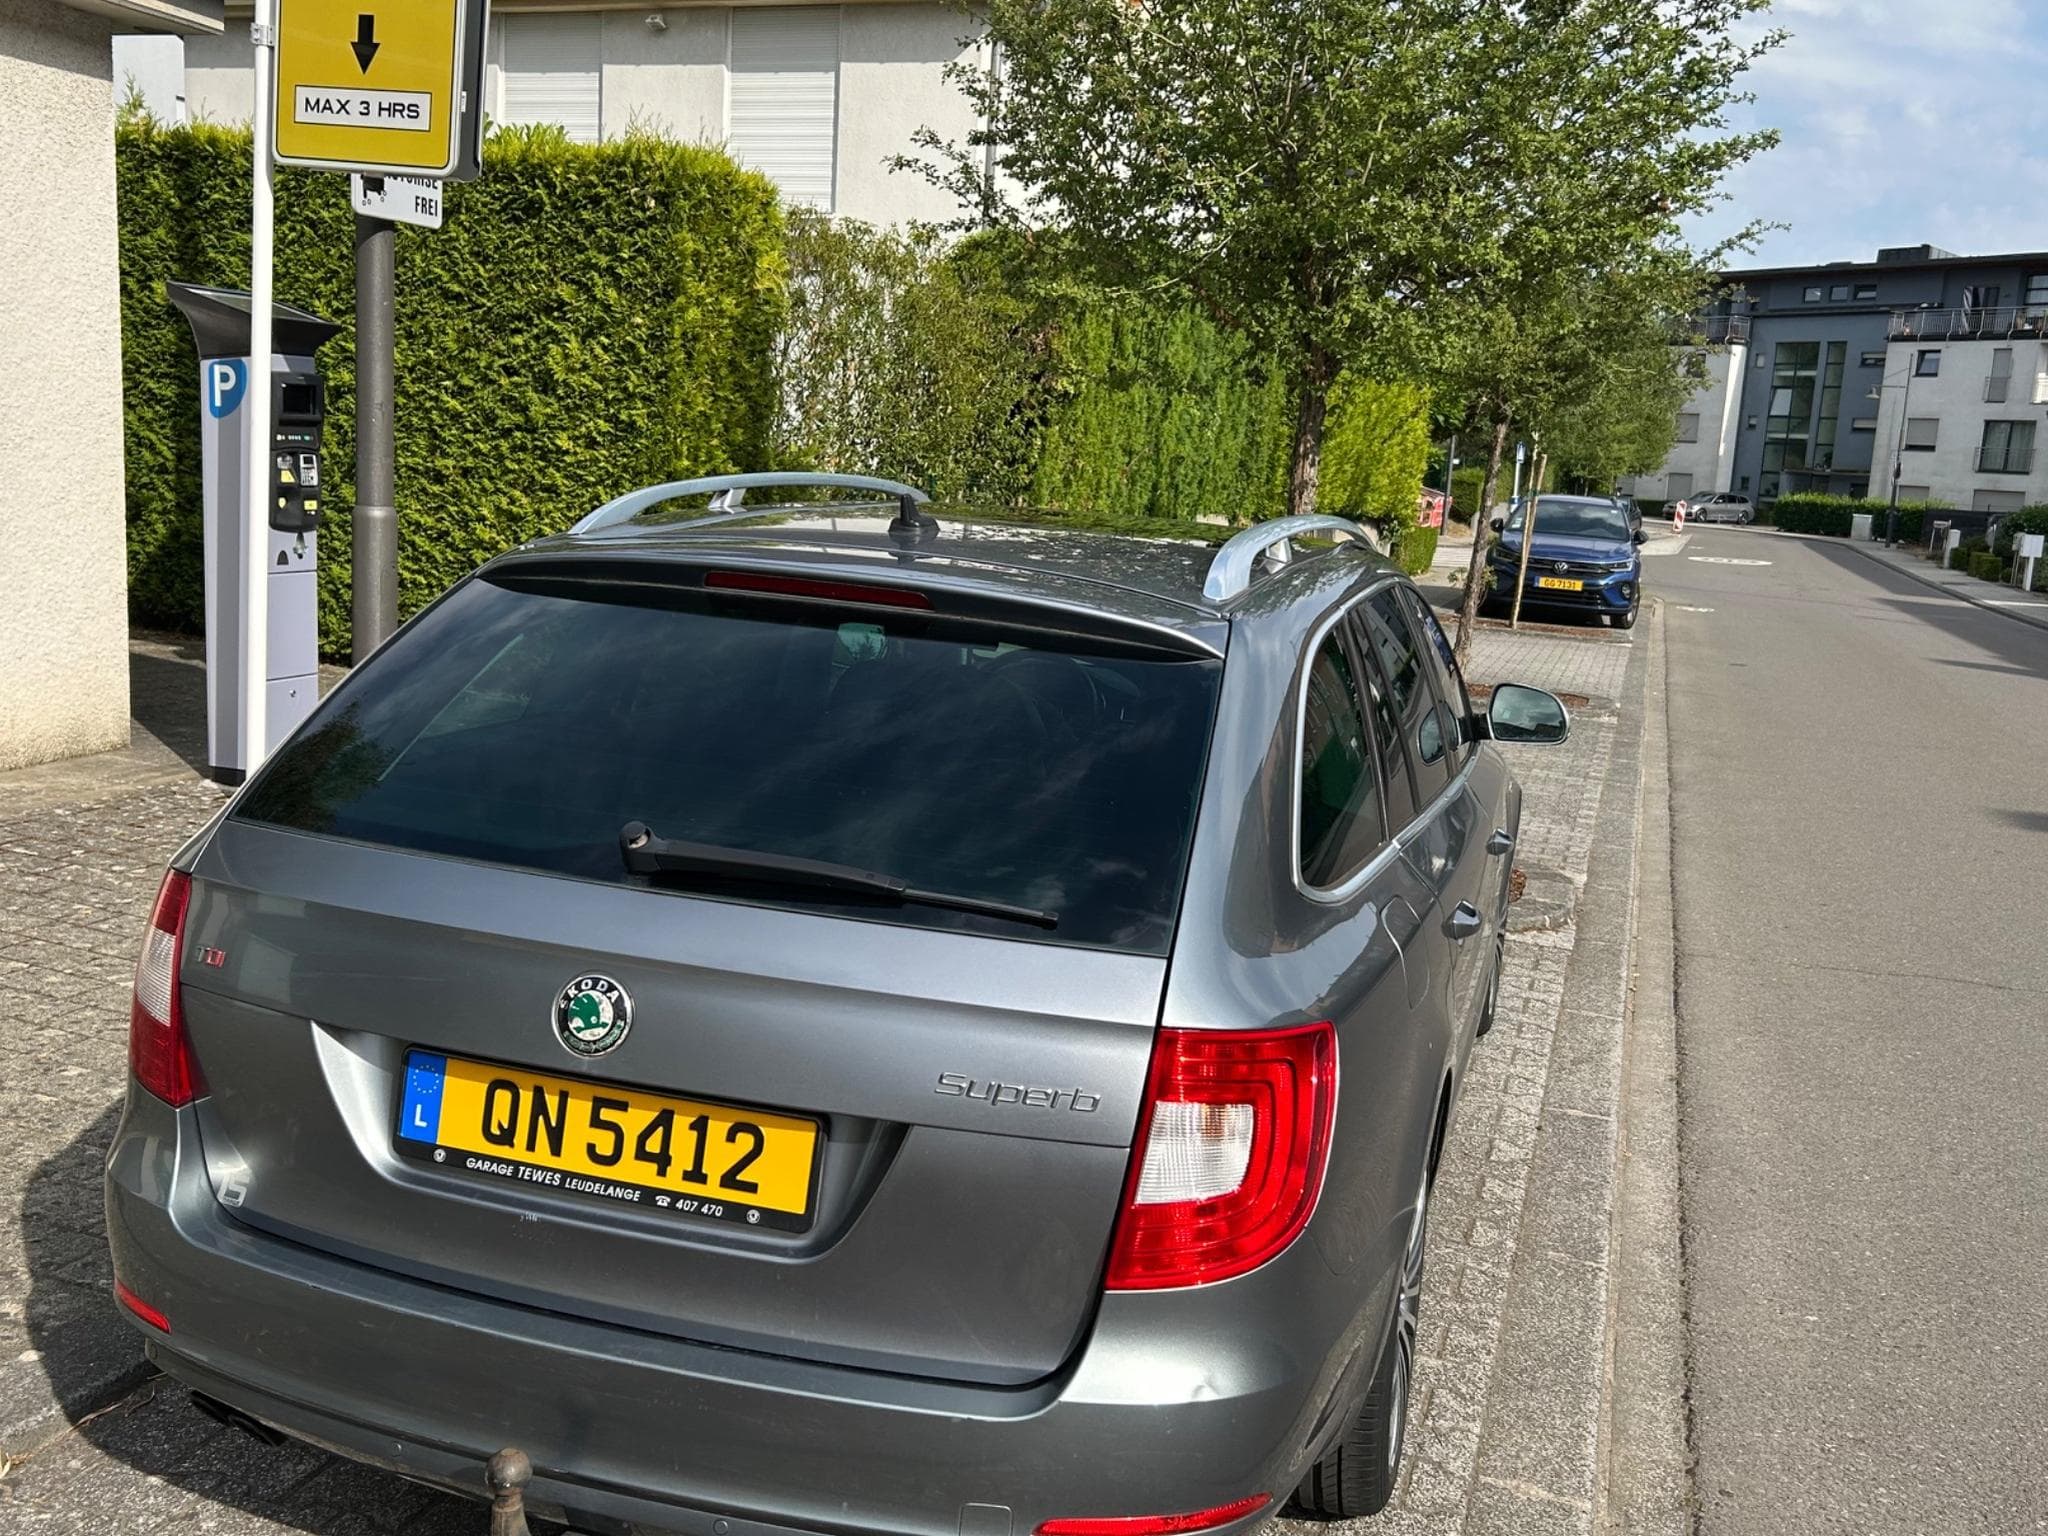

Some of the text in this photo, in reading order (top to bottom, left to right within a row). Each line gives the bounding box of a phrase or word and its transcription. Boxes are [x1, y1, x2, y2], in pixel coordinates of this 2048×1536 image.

[305, 97, 420, 119] MAX 3 HRS
[415, 195, 438, 217] FREI
[213, 364, 236, 407] P
[934, 1071, 1102, 1112] Superb
[414, 1103, 428, 1128] L
[482, 1079, 765, 1194] QN 5412
[466, 1157, 724, 1217] GARAGE TEWES LEUDELANGE 407 470
